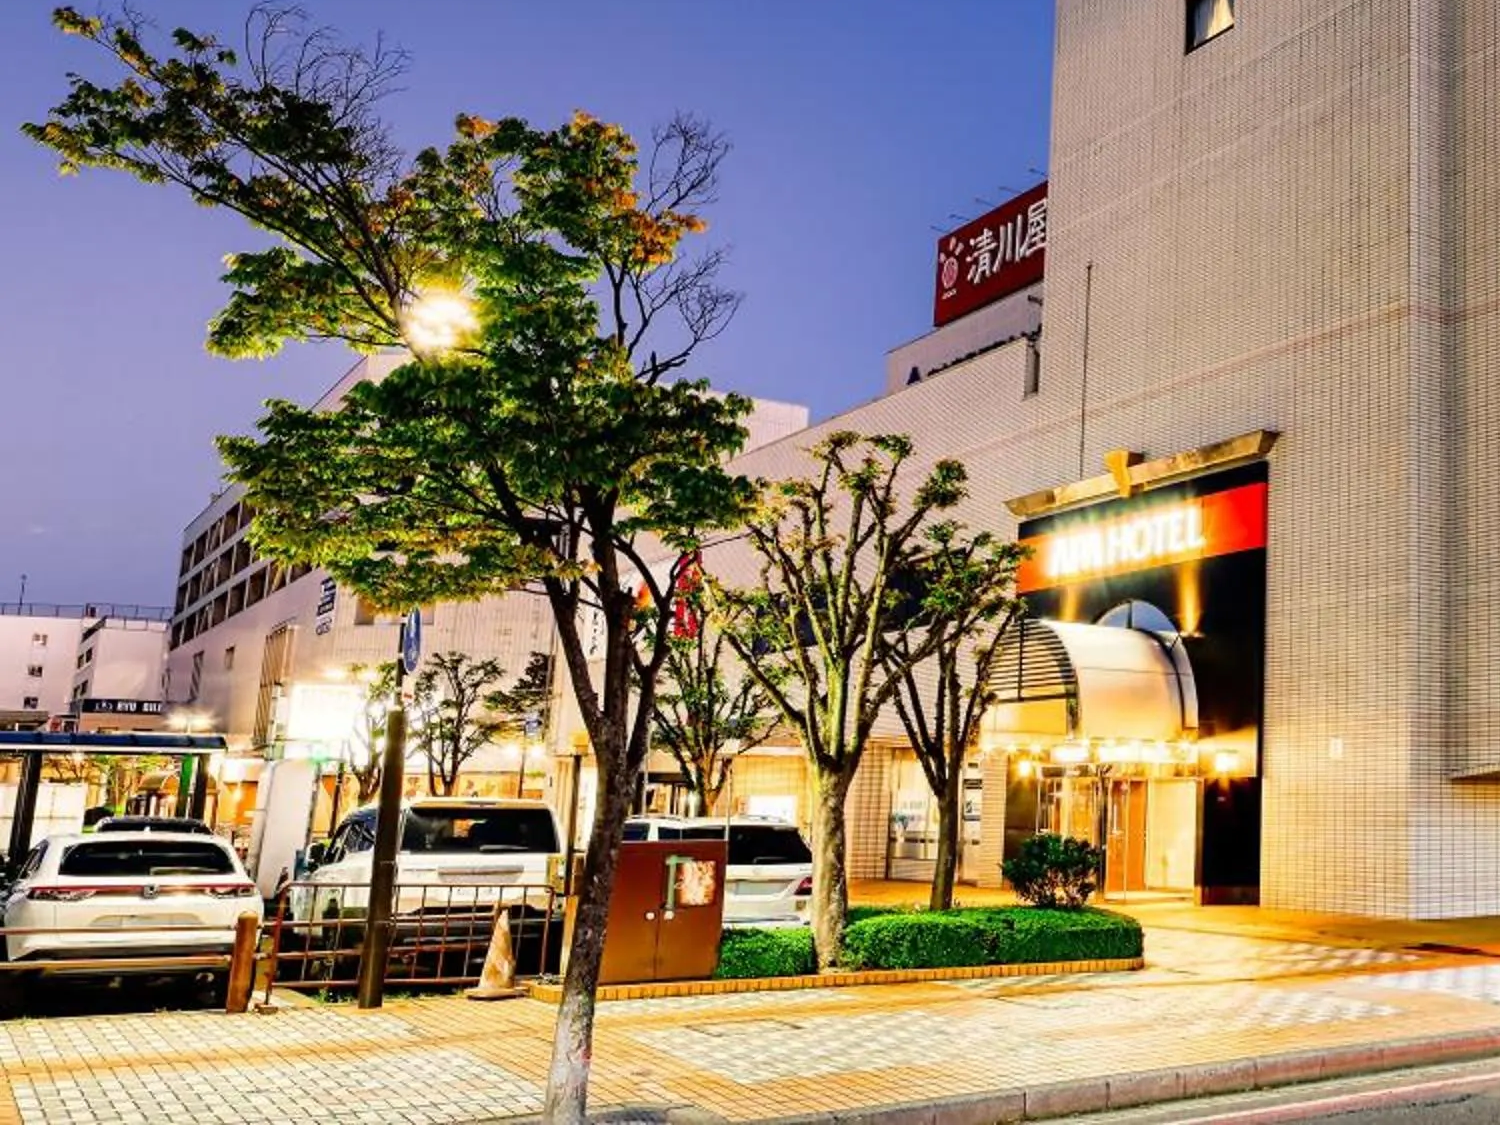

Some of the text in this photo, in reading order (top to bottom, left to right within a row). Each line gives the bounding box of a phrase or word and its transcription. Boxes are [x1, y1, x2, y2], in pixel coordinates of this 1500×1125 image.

[965, 197, 1047, 284] 清川屋
[1106, 505, 1206, 565] HOTEL
